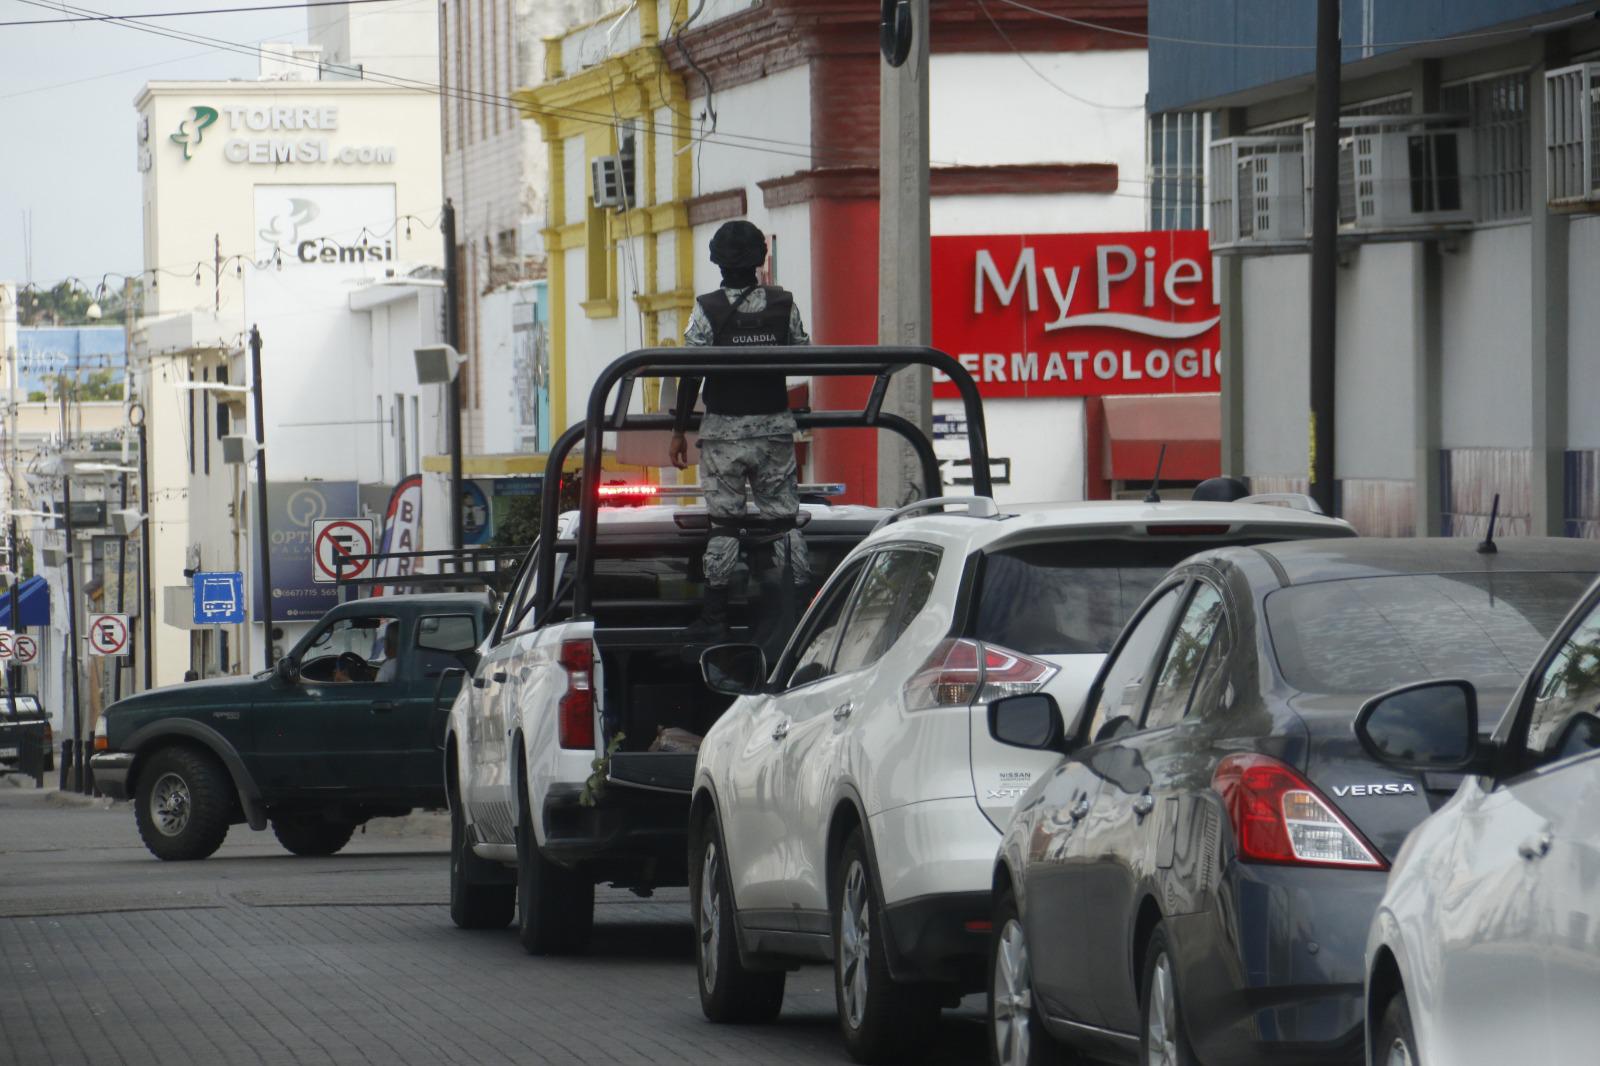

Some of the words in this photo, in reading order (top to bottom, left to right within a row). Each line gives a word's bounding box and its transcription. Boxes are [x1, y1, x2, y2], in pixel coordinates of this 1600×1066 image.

[223, 106, 338, 131] TORRE
[224, 138, 329, 163] CEMSI
[297, 240, 393, 263] Cemsi
[974, 247, 1081, 332] My
[732, 334, 776, 343] GUARDIA
[932, 348, 1221, 383] ERMATOLOGI
[102, 625, 114, 645] E
[1332, 783, 1417, 797] VERSA
